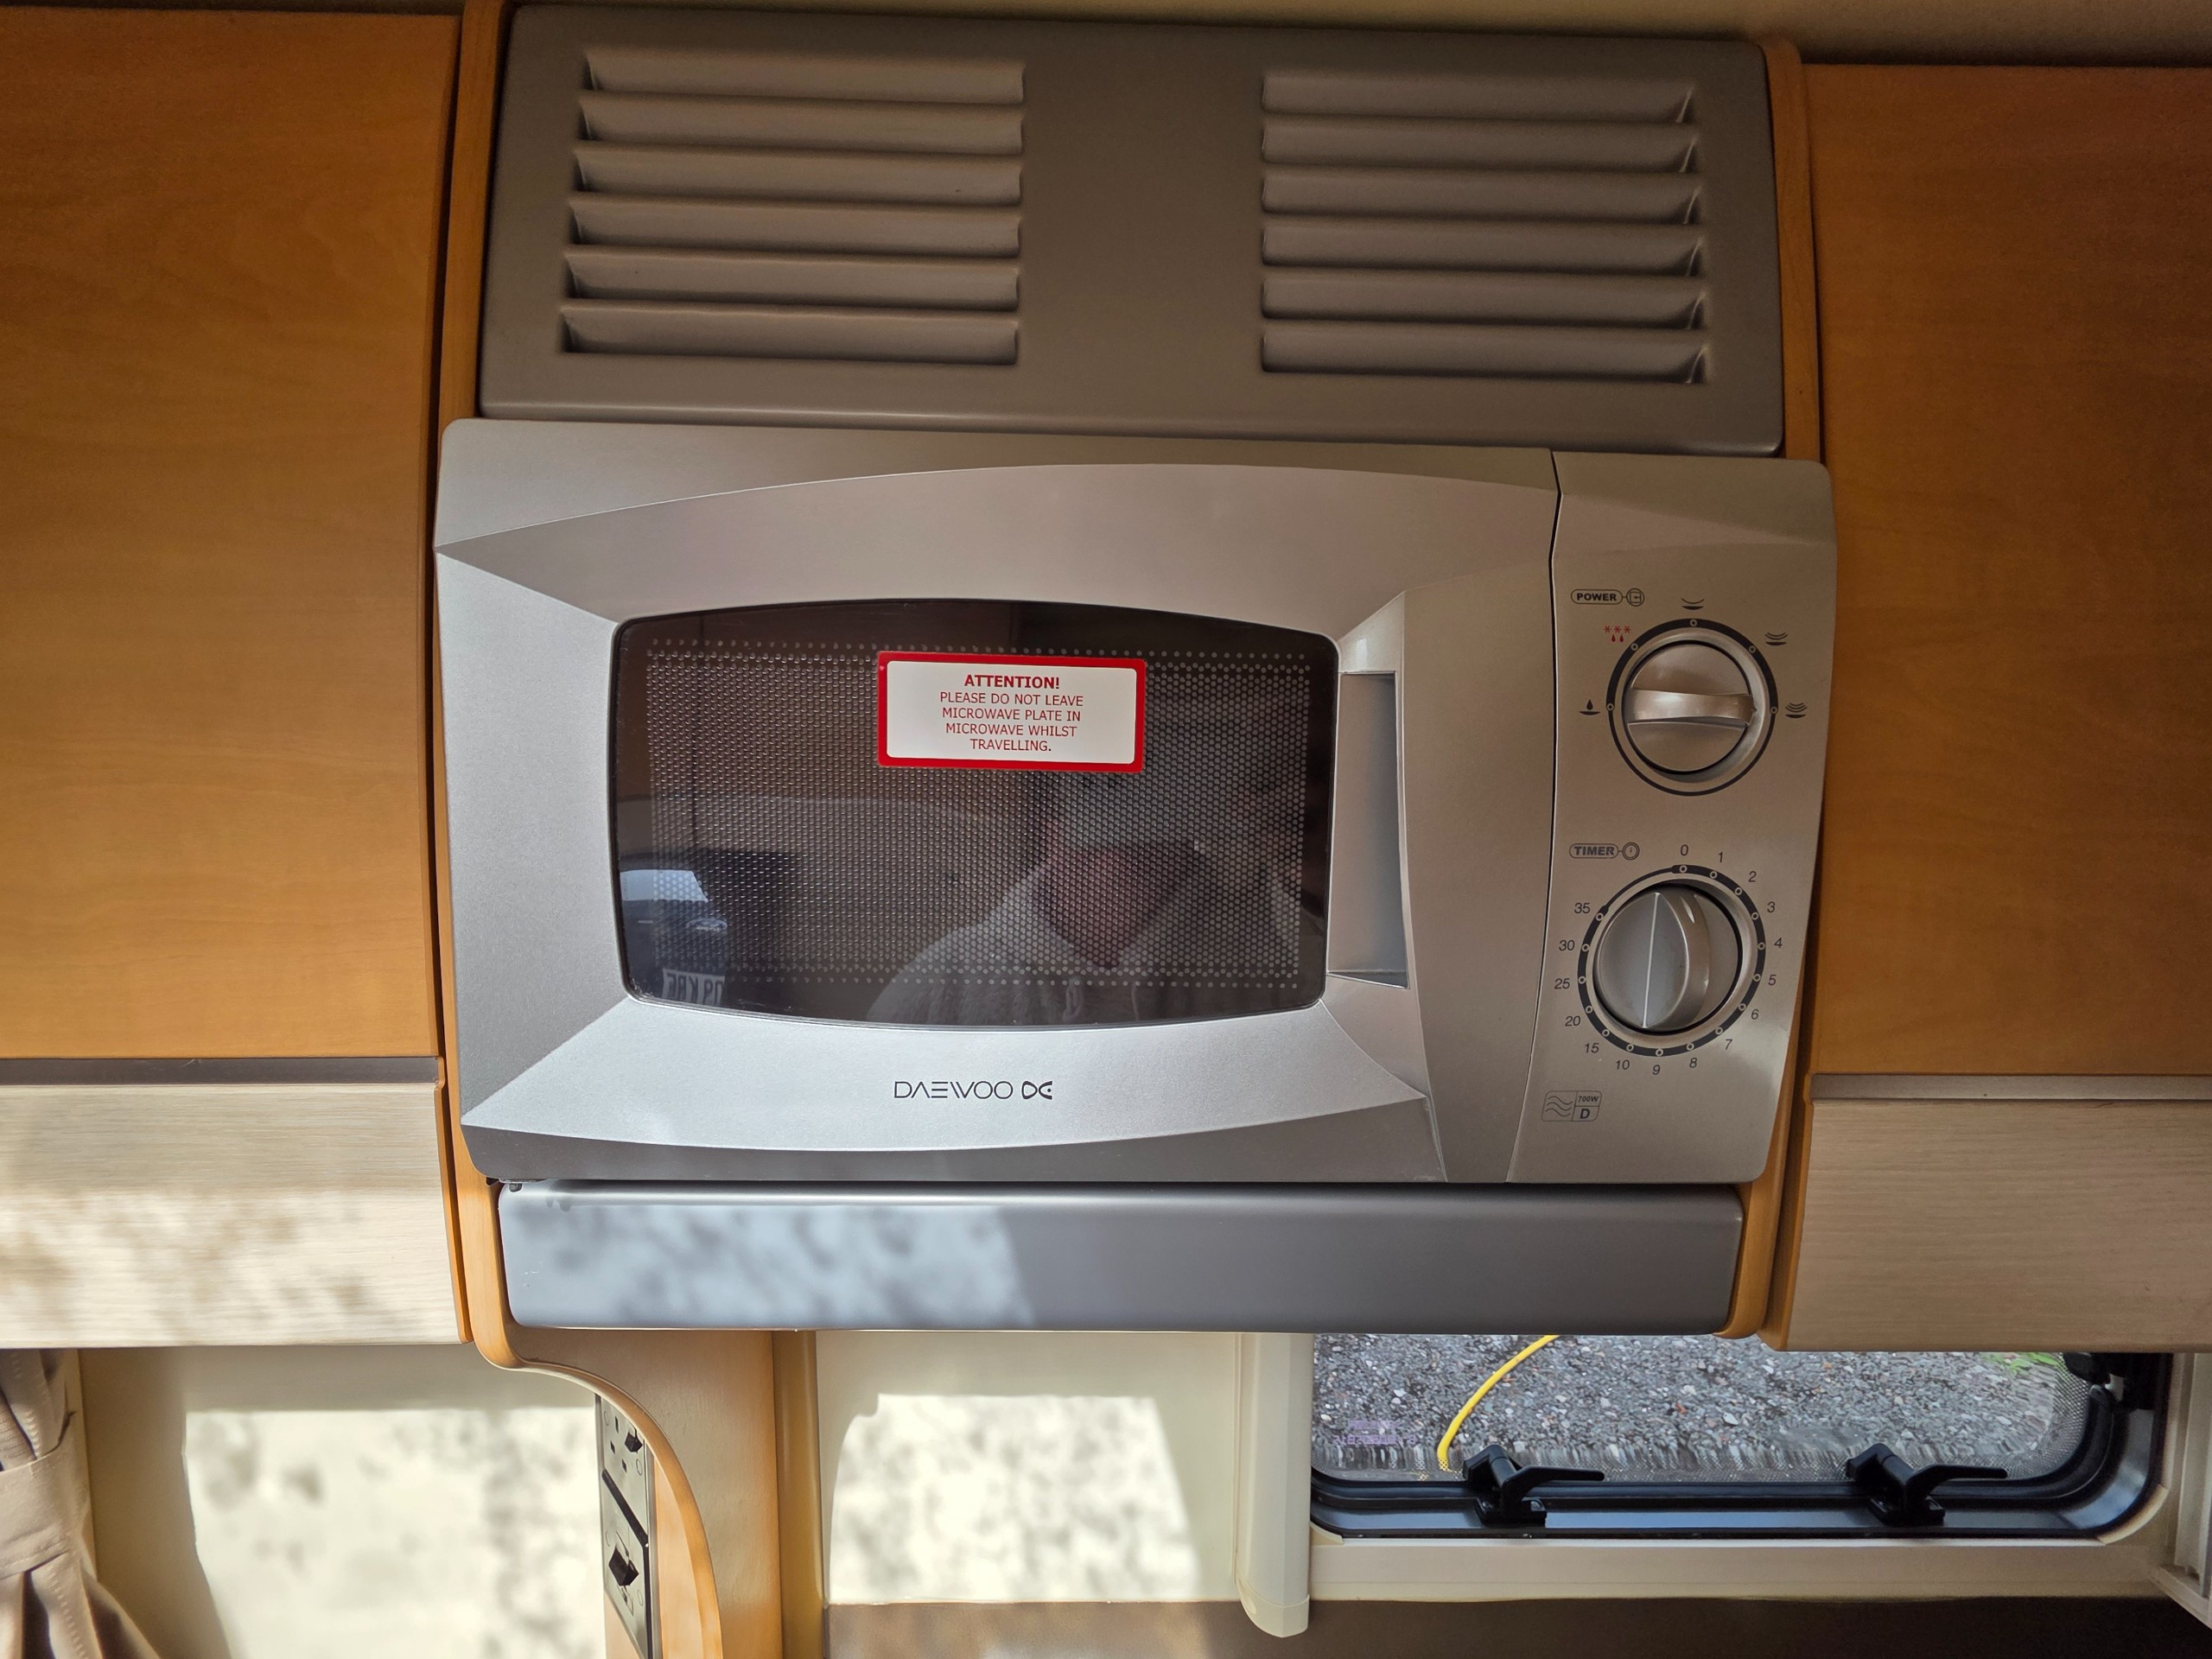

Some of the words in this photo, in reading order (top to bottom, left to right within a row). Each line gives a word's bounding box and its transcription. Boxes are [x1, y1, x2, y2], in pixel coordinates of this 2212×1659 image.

[1576, 593, 1617, 601] POWER
[964, 674, 1059, 689] ATTENTION!
[940, 692, 986, 703] PLEASE
[991, 693, 1009, 704] DO
[1014, 694, 1040, 705] NOT
[1046, 696, 1084, 706] LEAVE
[943, 708, 1020, 720] MICROWAVE
[1025, 710, 1061, 721] PLATE
[1066, 711, 1080, 721] IN
[946, 722, 1023, 735] MICROWAVE
[1028, 725, 1077, 737] WHILST
[970, 739, 1052, 751] TRAVELLING.
[1573, 846, 1615, 855] TIMER
[1681, 844, 1688, 855] 0
[1749, 871, 1757, 882] 2
[1574, 903, 1590, 913] 35
[1767, 901, 1775, 912] 3
[1559, 940, 1574, 950] 30
[1774, 938, 1783, 948] 4
[1554, 978, 1570, 989] 25
[1769, 975, 1776, 986] 5
[1751, 1009, 1759, 1020] 6
[1565, 1016, 1580, 1027] 20
[1586, 1043, 1599, 1053] 15
[1726, 1039, 1732, 1050] 7
[1617, 1060, 1630, 1070] 10
[1689, 1058, 1697, 1068] 8
[1653, 1065, 1660, 1075] 9
[894, 1081, 1013, 1099] DAEWOO
[1580, 1109, 1590, 1119] D
